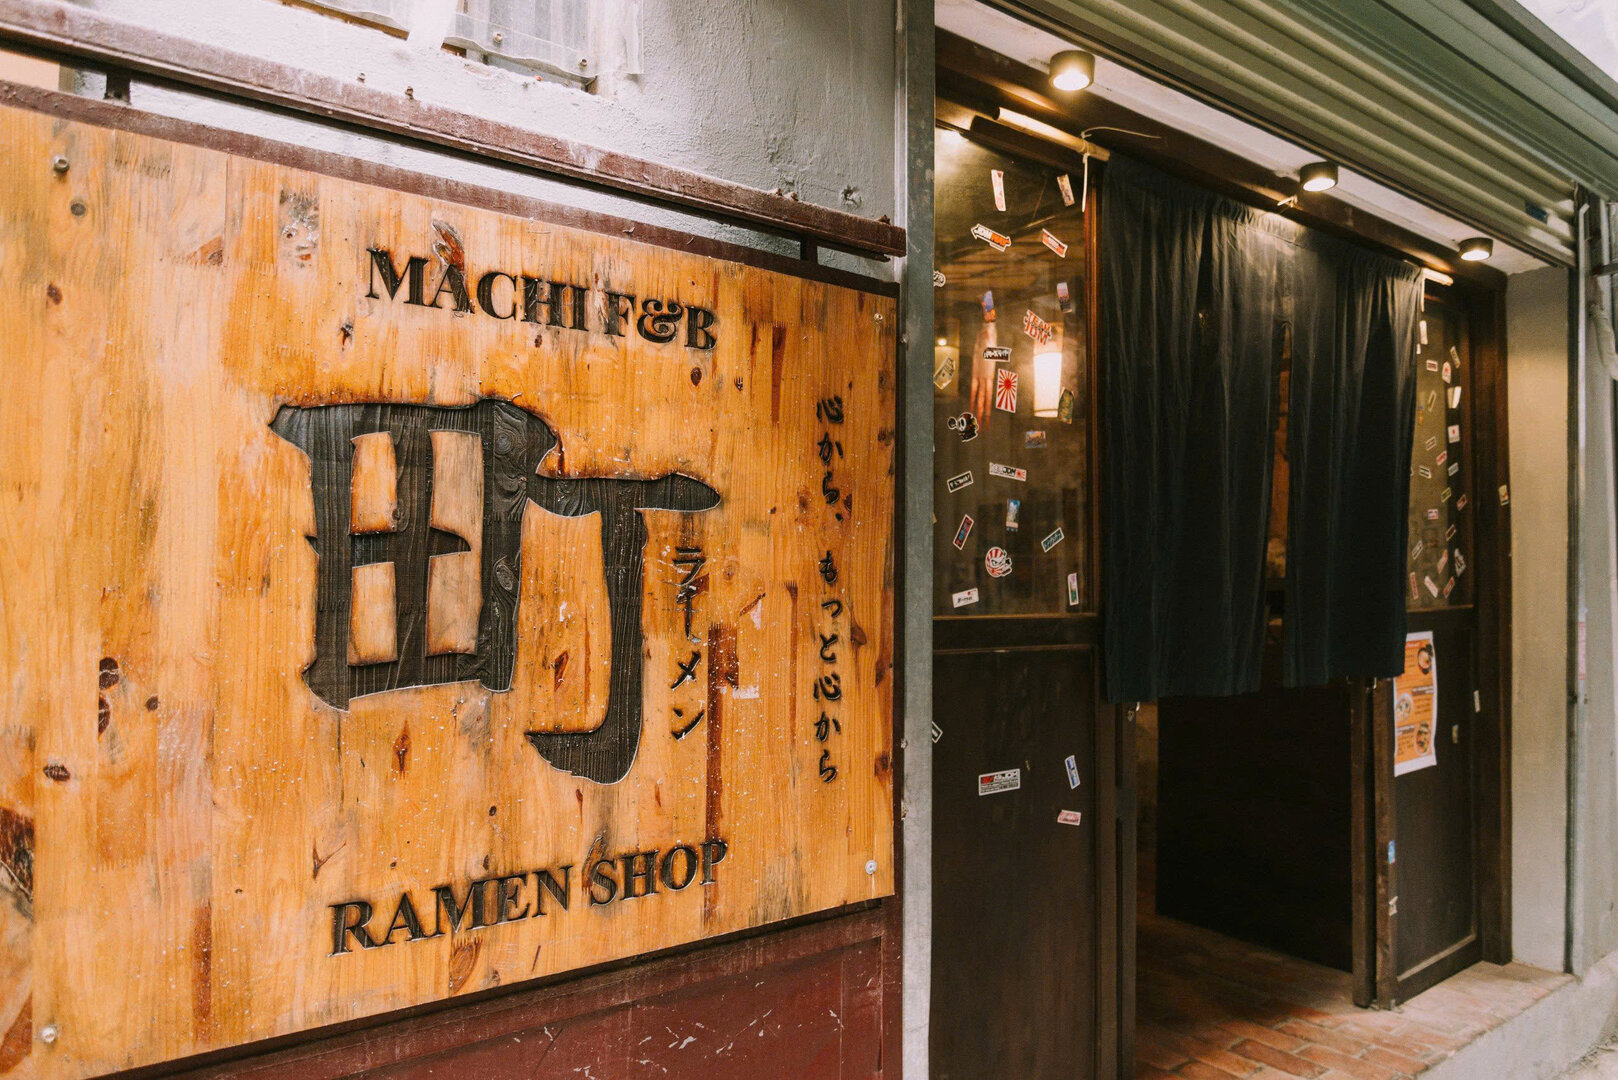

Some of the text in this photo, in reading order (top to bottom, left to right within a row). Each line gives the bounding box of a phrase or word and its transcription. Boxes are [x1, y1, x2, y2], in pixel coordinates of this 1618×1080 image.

[366, 248, 717, 350] MACHI F&B
[670, 546, 707, 742] ラーメン
[327, 840, 729, 958] RAMEN SHOP
